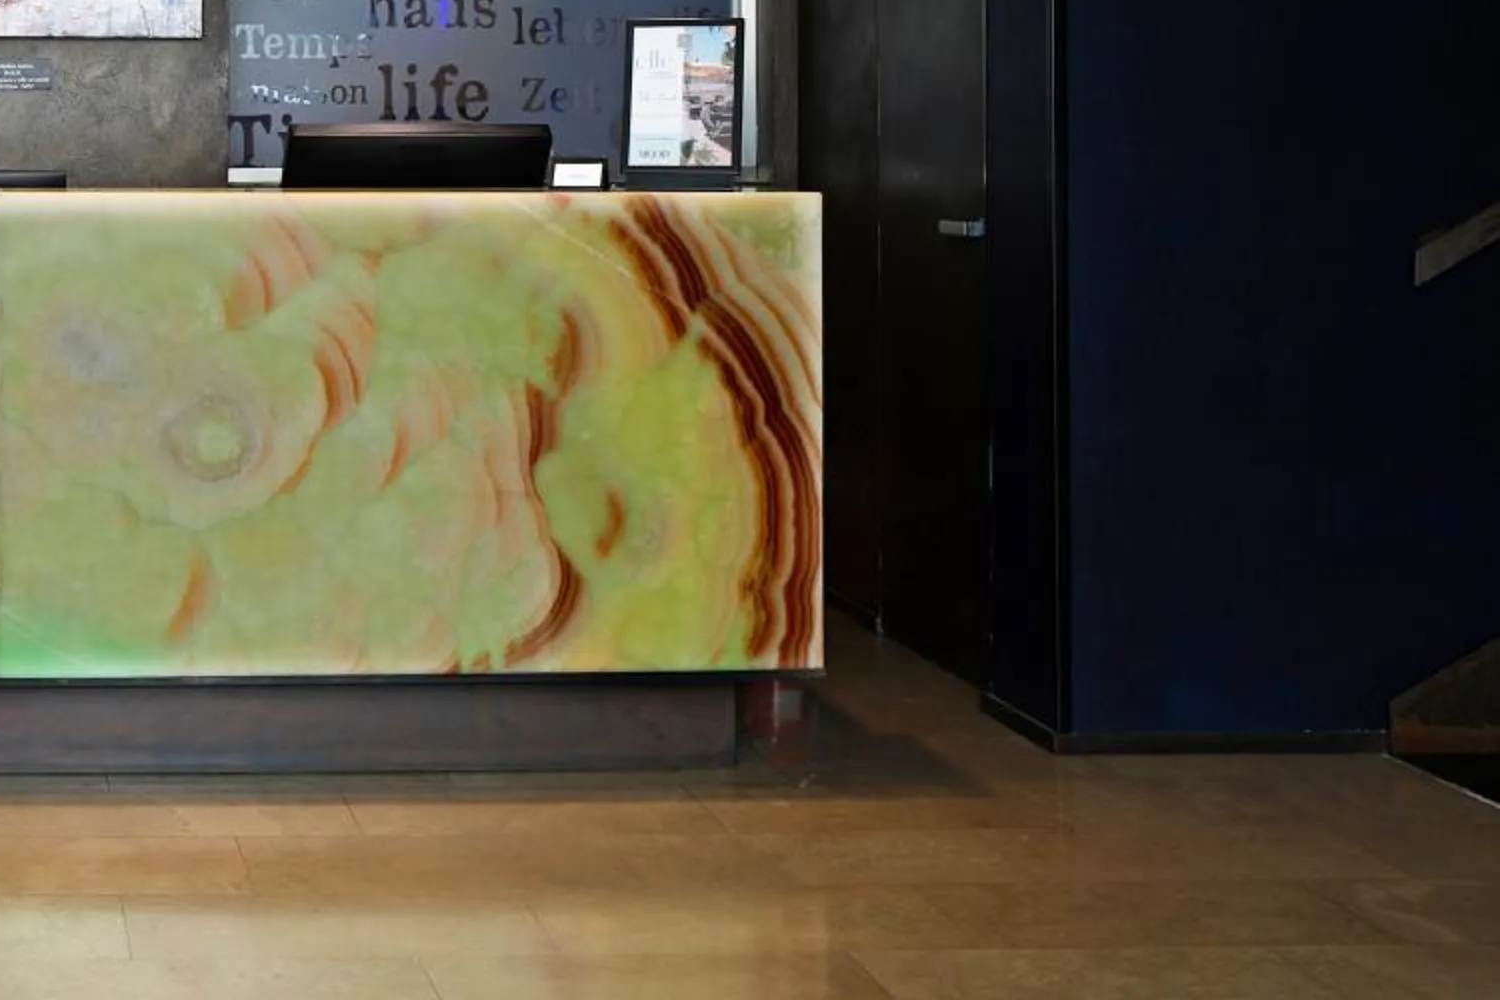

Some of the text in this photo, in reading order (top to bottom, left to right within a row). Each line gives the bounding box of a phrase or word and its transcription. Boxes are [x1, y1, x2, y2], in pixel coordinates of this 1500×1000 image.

[235, 23, 373, 69] Temps
[378, 63, 490, 122] life
[228, 114, 293, 168] Ti
